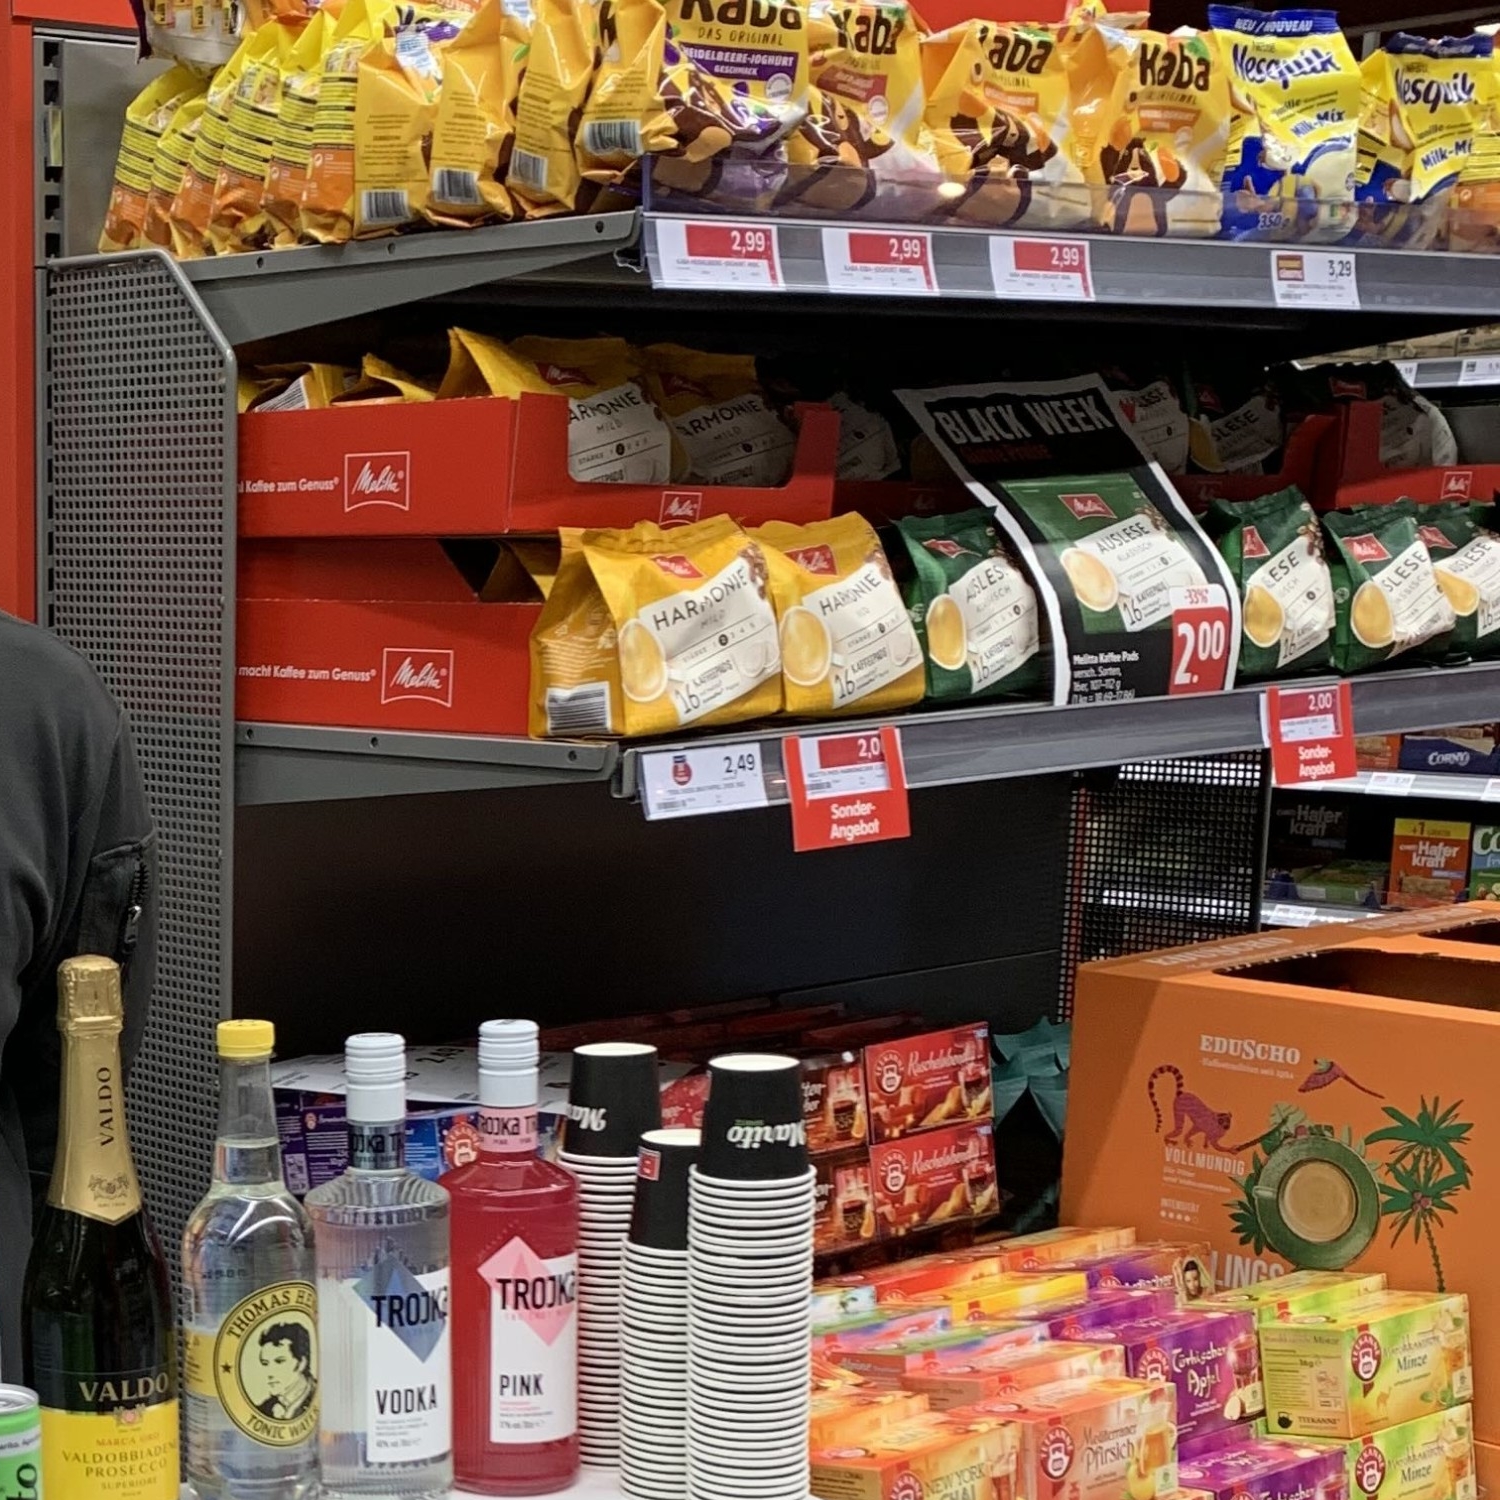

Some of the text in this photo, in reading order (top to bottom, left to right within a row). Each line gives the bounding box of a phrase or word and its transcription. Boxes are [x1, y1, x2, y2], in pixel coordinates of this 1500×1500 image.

[698, 26, 784, 47] DAS ORIGINAL
[1139, 41, 1211, 92] Kaba
[1232, 43, 1342, 89] Nesquik
[1292, 108, 1346, 138] Milk-Mix
[1420, 140, 1474, 172] Milk-Mi
[730, 230, 766, 253] 2,99
[889, 238, 921, 260] 2,99
[1050, 246, 1080, 268] 2,99
[1327, 259, 1353, 279] 3,29
[932, 394, 1115, 446] BLACK WEEK
[245, 480, 276, 493] Kaffee
[277, 482, 297, 493] zum
[351, 460, 399, 495] Melitta
[1097, 521, 1151, 555] AUSLESE
[653, 567, 749, 632] HARMONIE
[1123, 599, 1143, 627] 16
[1072, 650, 1140, 666] Melitta Kaffee Pads
[238, 665, 272, 678] macht
[273, 665, 306, 679] Kaffee
[308, 669, 330, 680] zum
[390, 656, 442, 690] Melitta
[674, 681, 701, 715] 16
[834, 672, 855, 701] 16
[1308, 692, 1333, 712] 2,00
[857, 737, 881, 758] 2,0
[1298, 745, 1332, 760] Sonder-
[722, 753, 756, 775] 2,49
[1299, 761, 1336, 780] Angebot
[830, 800, 877, 820] Sonder-
[1297, 805, 1343, 825] Hafer
[829, 819, 880, 841] Angebot
[1411, 851, 1446, 868] kraft
[1418, 841, 1460, 858] Hafer
[1200, 1034, 1301, 1066] EDUSCHO
[98, 1065, 114, 1148] VALDO
[1164, 1147, 1246, 1176] VOLLMUNDIG
[226, 1289, 292, 1340] THOMAS
[1396, 1352, 1428, 1374] Minze
[78, 1372, 170, 1402] VALDO
[499, 1373, 544, 1397] PINK
[375, 1384, 438, 1415] VODKA
[246, 1413, 288, 1440] TONIC
[95, 1436, 137, 1447] MARCA
[85, 1457, 168, 1478] PROSECCO
[1082, 1439, 1137, 1474] Pfirsich
[100, 1477, 158, 1490] SUPERIORE
[924, 1462, 986, 1497] NEW YORK
[1400, 1463, 1432, 1486] Minze
